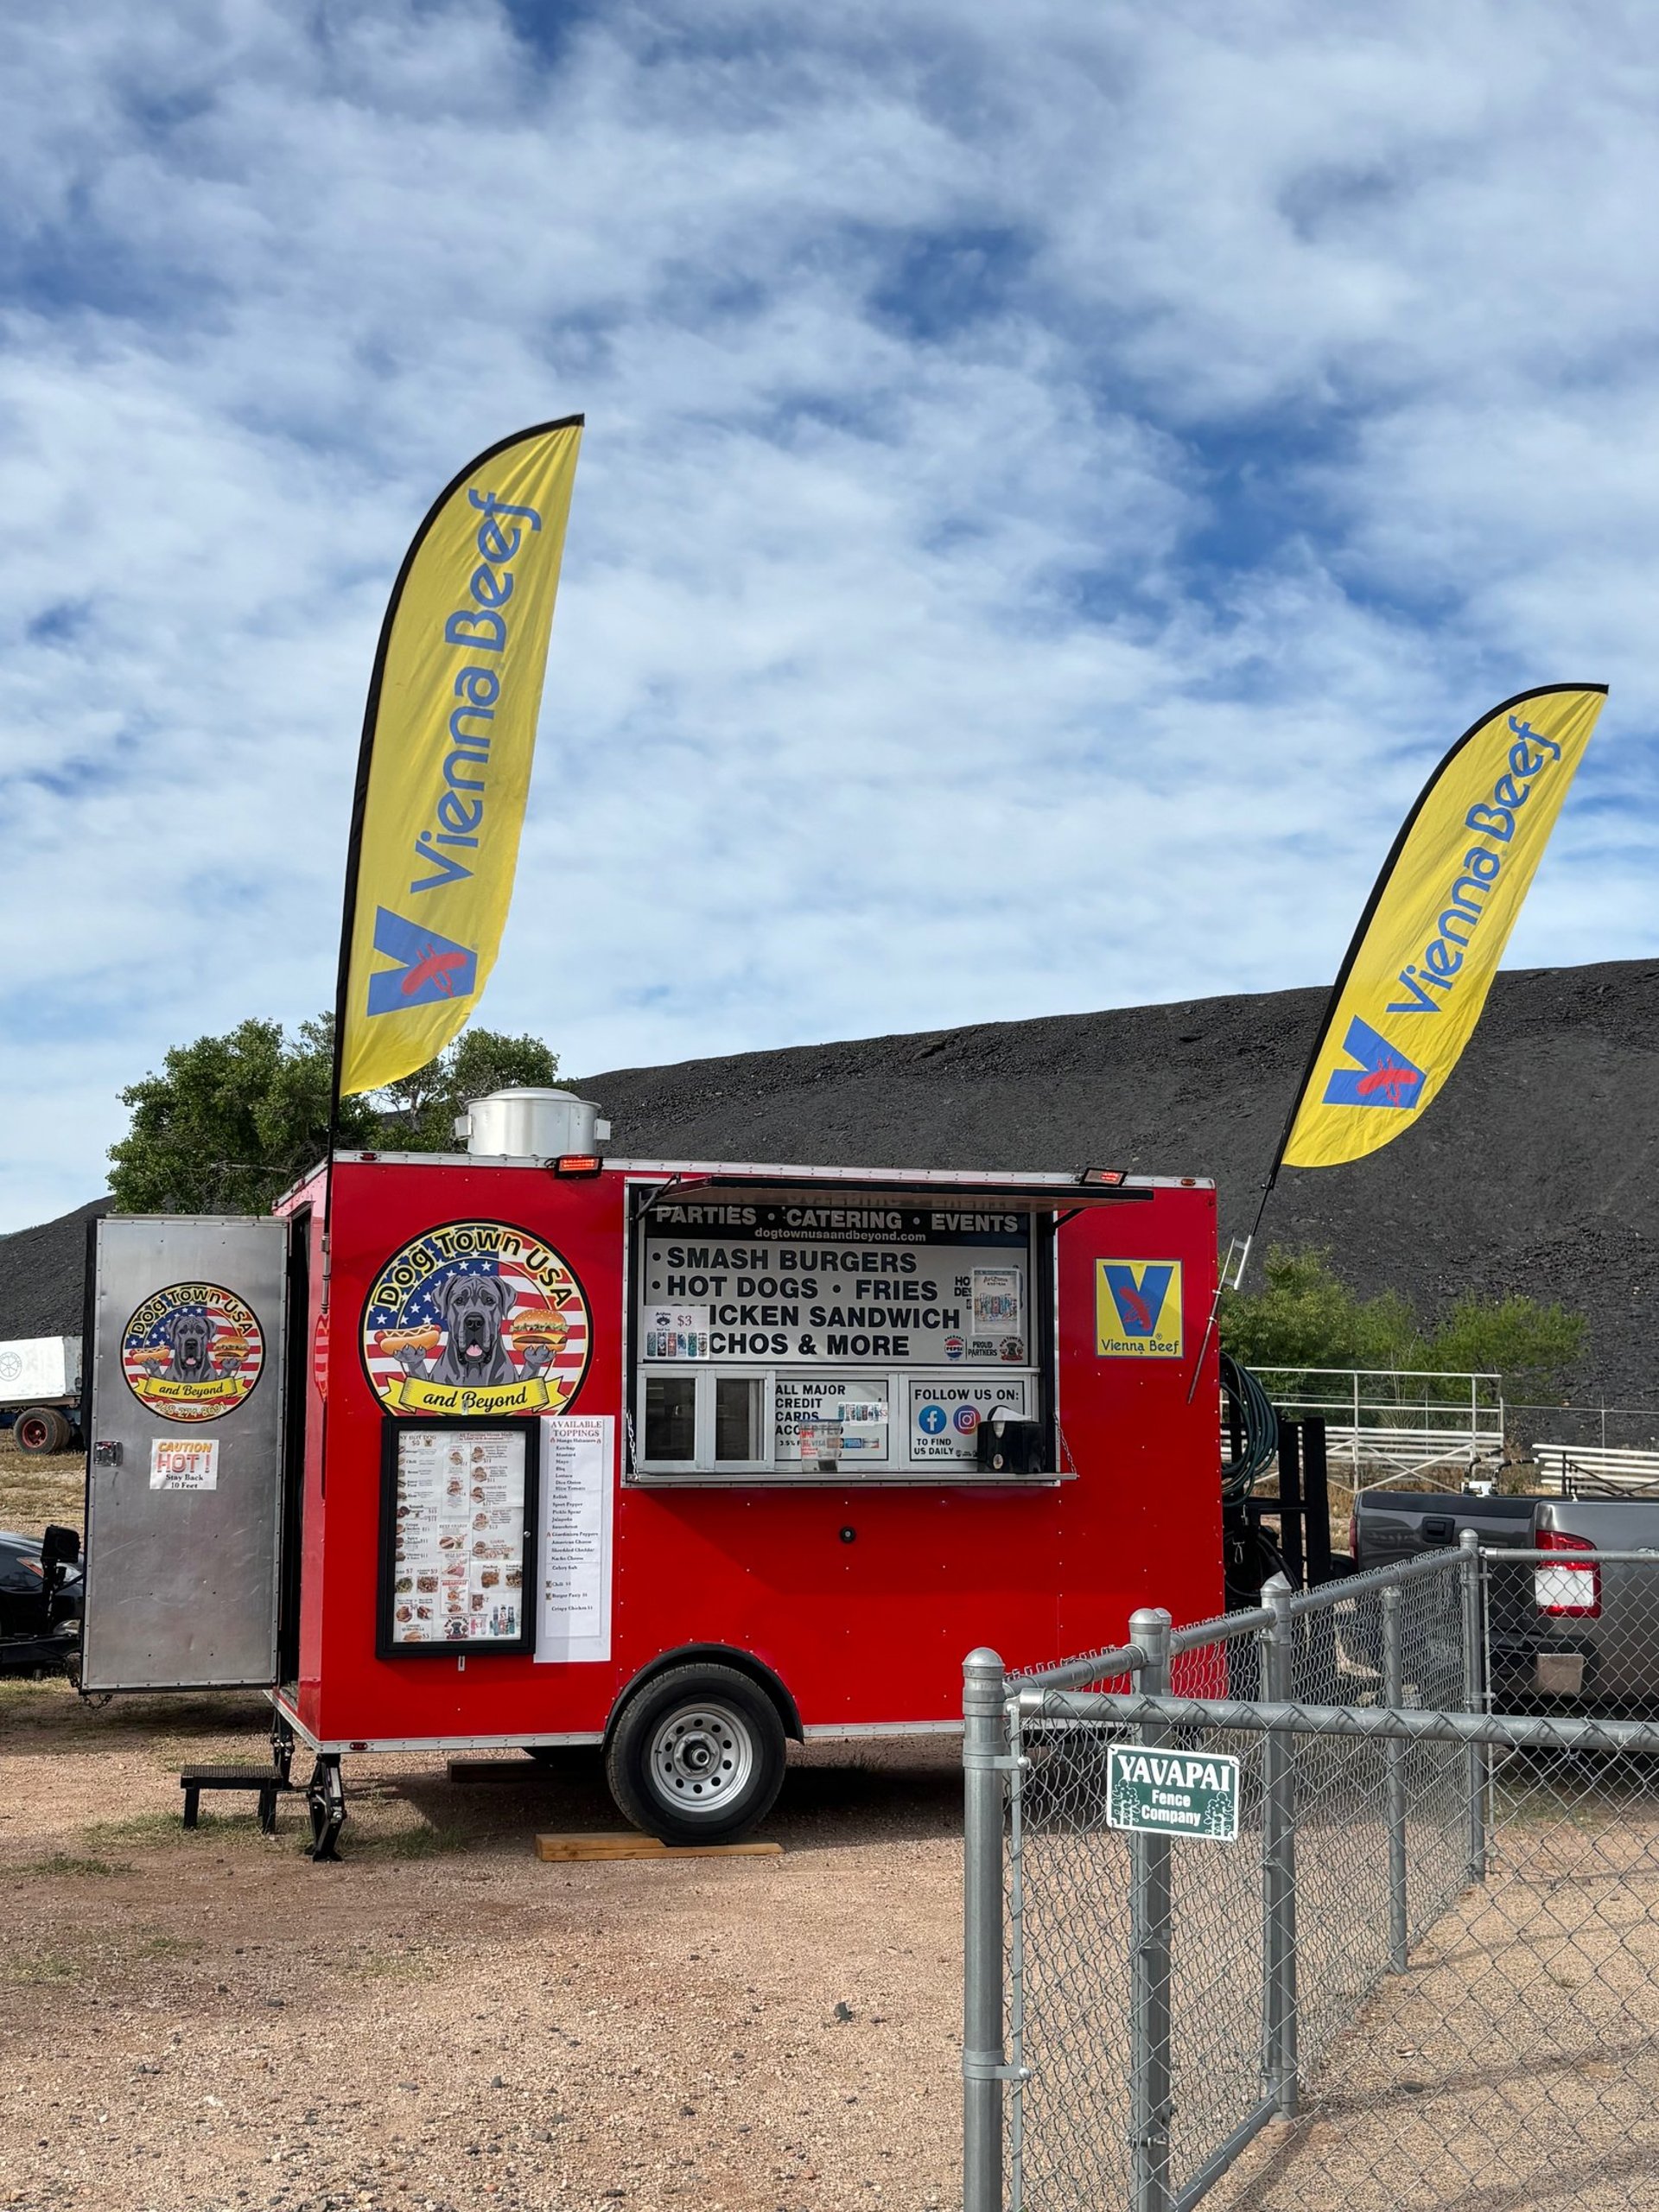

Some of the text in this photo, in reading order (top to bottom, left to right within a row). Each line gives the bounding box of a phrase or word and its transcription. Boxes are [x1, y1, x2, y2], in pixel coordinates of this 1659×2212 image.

[410, 488, 541, 893] Vienna Beef
[1386, 715, 1560, 1013] Vienna Beef
[656, 1205, 1019, 1233] PARTIES CATERING EVENTS
[754, 1227, 926, 1243] dogtownusaandbeyond.com
[377, 1230, 573, 1307] Dog Town USA
[667, 1246, 918, 1274] SMASH BURGERS
[667, 1274, 938, 1301] HOT DOGS FRIES
[131, 1288, 254, 1335] Dog Town USA
[671, 1304, 960, 1329] ICKEN SANDWICH
[677, 1314, 692, 1327] $3
[709, 1332, 910, 1357] CHOS & MORE
[968, 1349, 997, 1357] PARTNERS
[1102, 1338, 1179, 1355] Vienna Beef
[158, 1382, 224, 1397] and Beyond
[423, 1386, 528, 1413] and Beyond
[775, 1384, 846, 1395] ALL MAJOR
[914, 1389, 1020, 1401] FOLLOW US ON:
[775, 1398, 823, 1408] CREDIT
[775, 1411, 819, 1422] CARDS
[158, 1442, 213, 1453] CAUTION
[157, 1452, 200, 1473] HOT
[165, 1473, 183, 1482] Stay
[1116, 1754, 1231, 1792] YAVAPAI
[1151, 1789, 1192, 1808] Fence
[1141, 1804, 1202, 1827] Company
